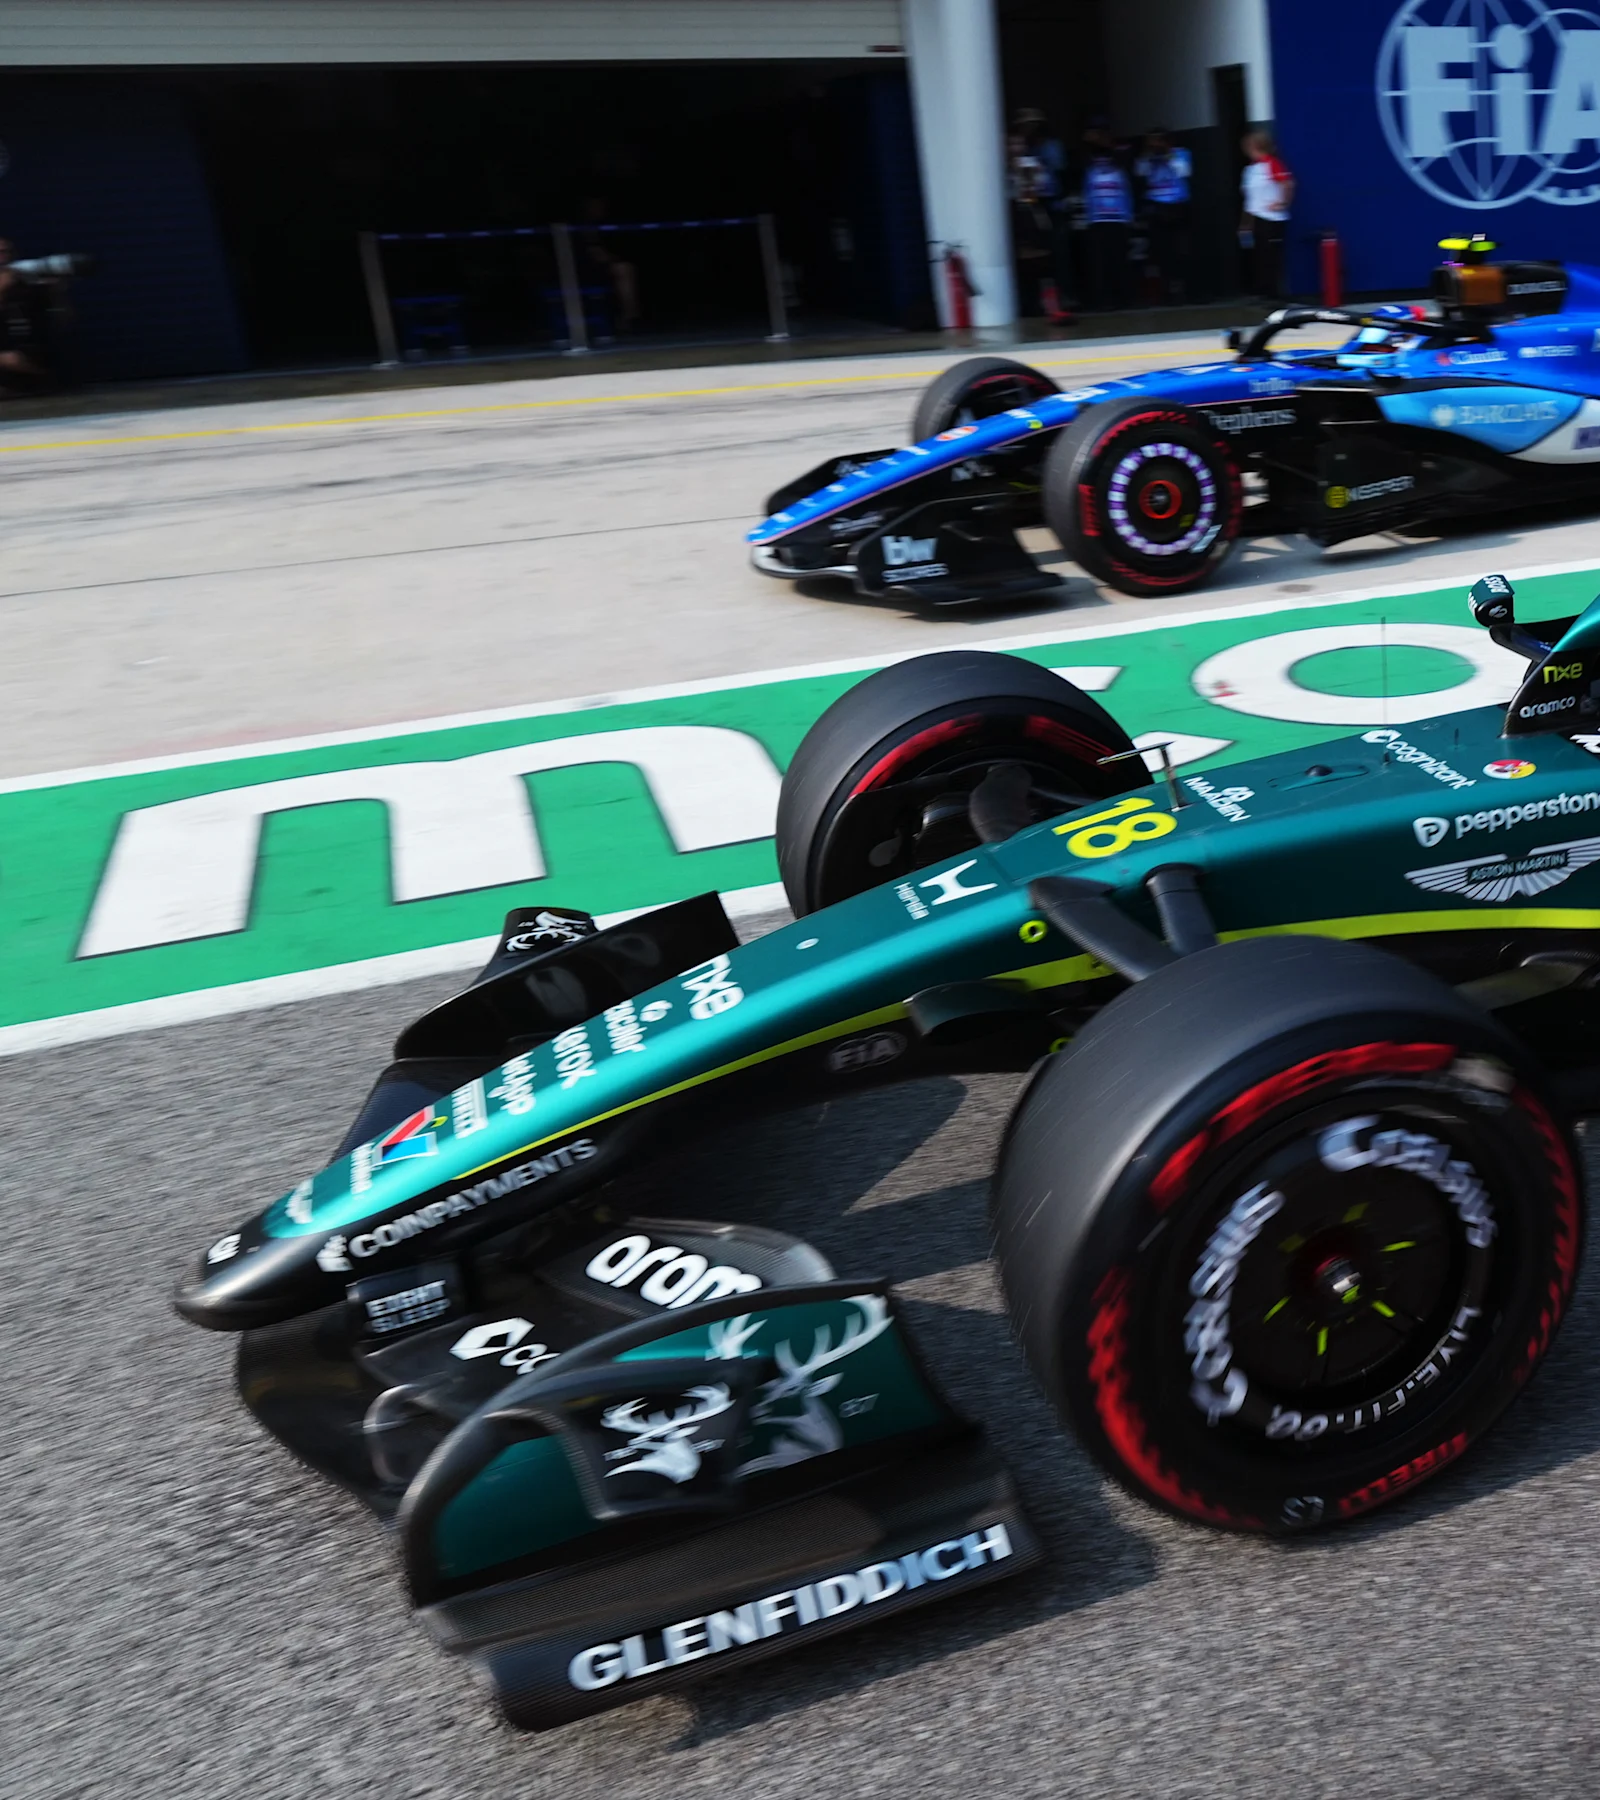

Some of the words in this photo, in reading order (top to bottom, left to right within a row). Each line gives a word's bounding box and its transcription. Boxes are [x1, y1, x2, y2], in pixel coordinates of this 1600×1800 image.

[1519, 696, 1576, 719] aramco
[1386, 741, 1477, 790] cognizant
[1183, 777, 1252, 823] MAADEN
[1052, 797, 1177, 859] 18
[1470, 861, 1514, 882] ASTON
[1515, 851, 1566, 875] MARTIN
[348, 1137, 599, 1258] COINPAYMENTS
[568, 1522, 1012, 1692] GLENFIDDICH
